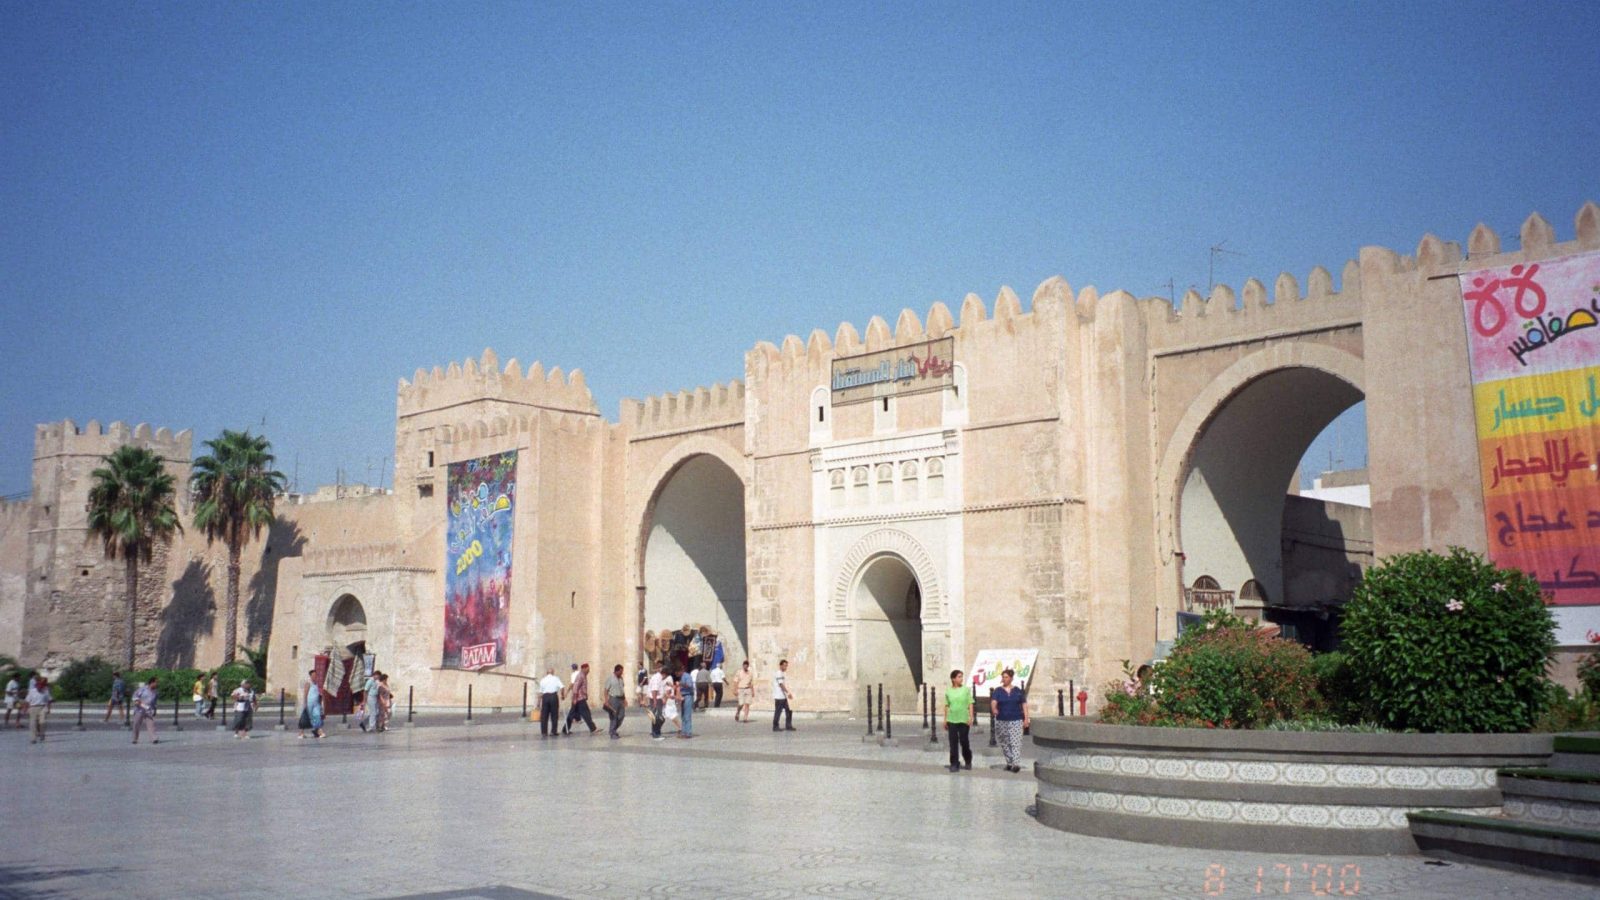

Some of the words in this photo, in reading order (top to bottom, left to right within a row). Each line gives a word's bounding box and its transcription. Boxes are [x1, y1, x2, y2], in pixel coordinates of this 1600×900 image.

[1491, 388, 1566, 432] جسار
[1490, 439, 1560, 489] الحجار
[1494, 500, 1576, 548] عجاج
